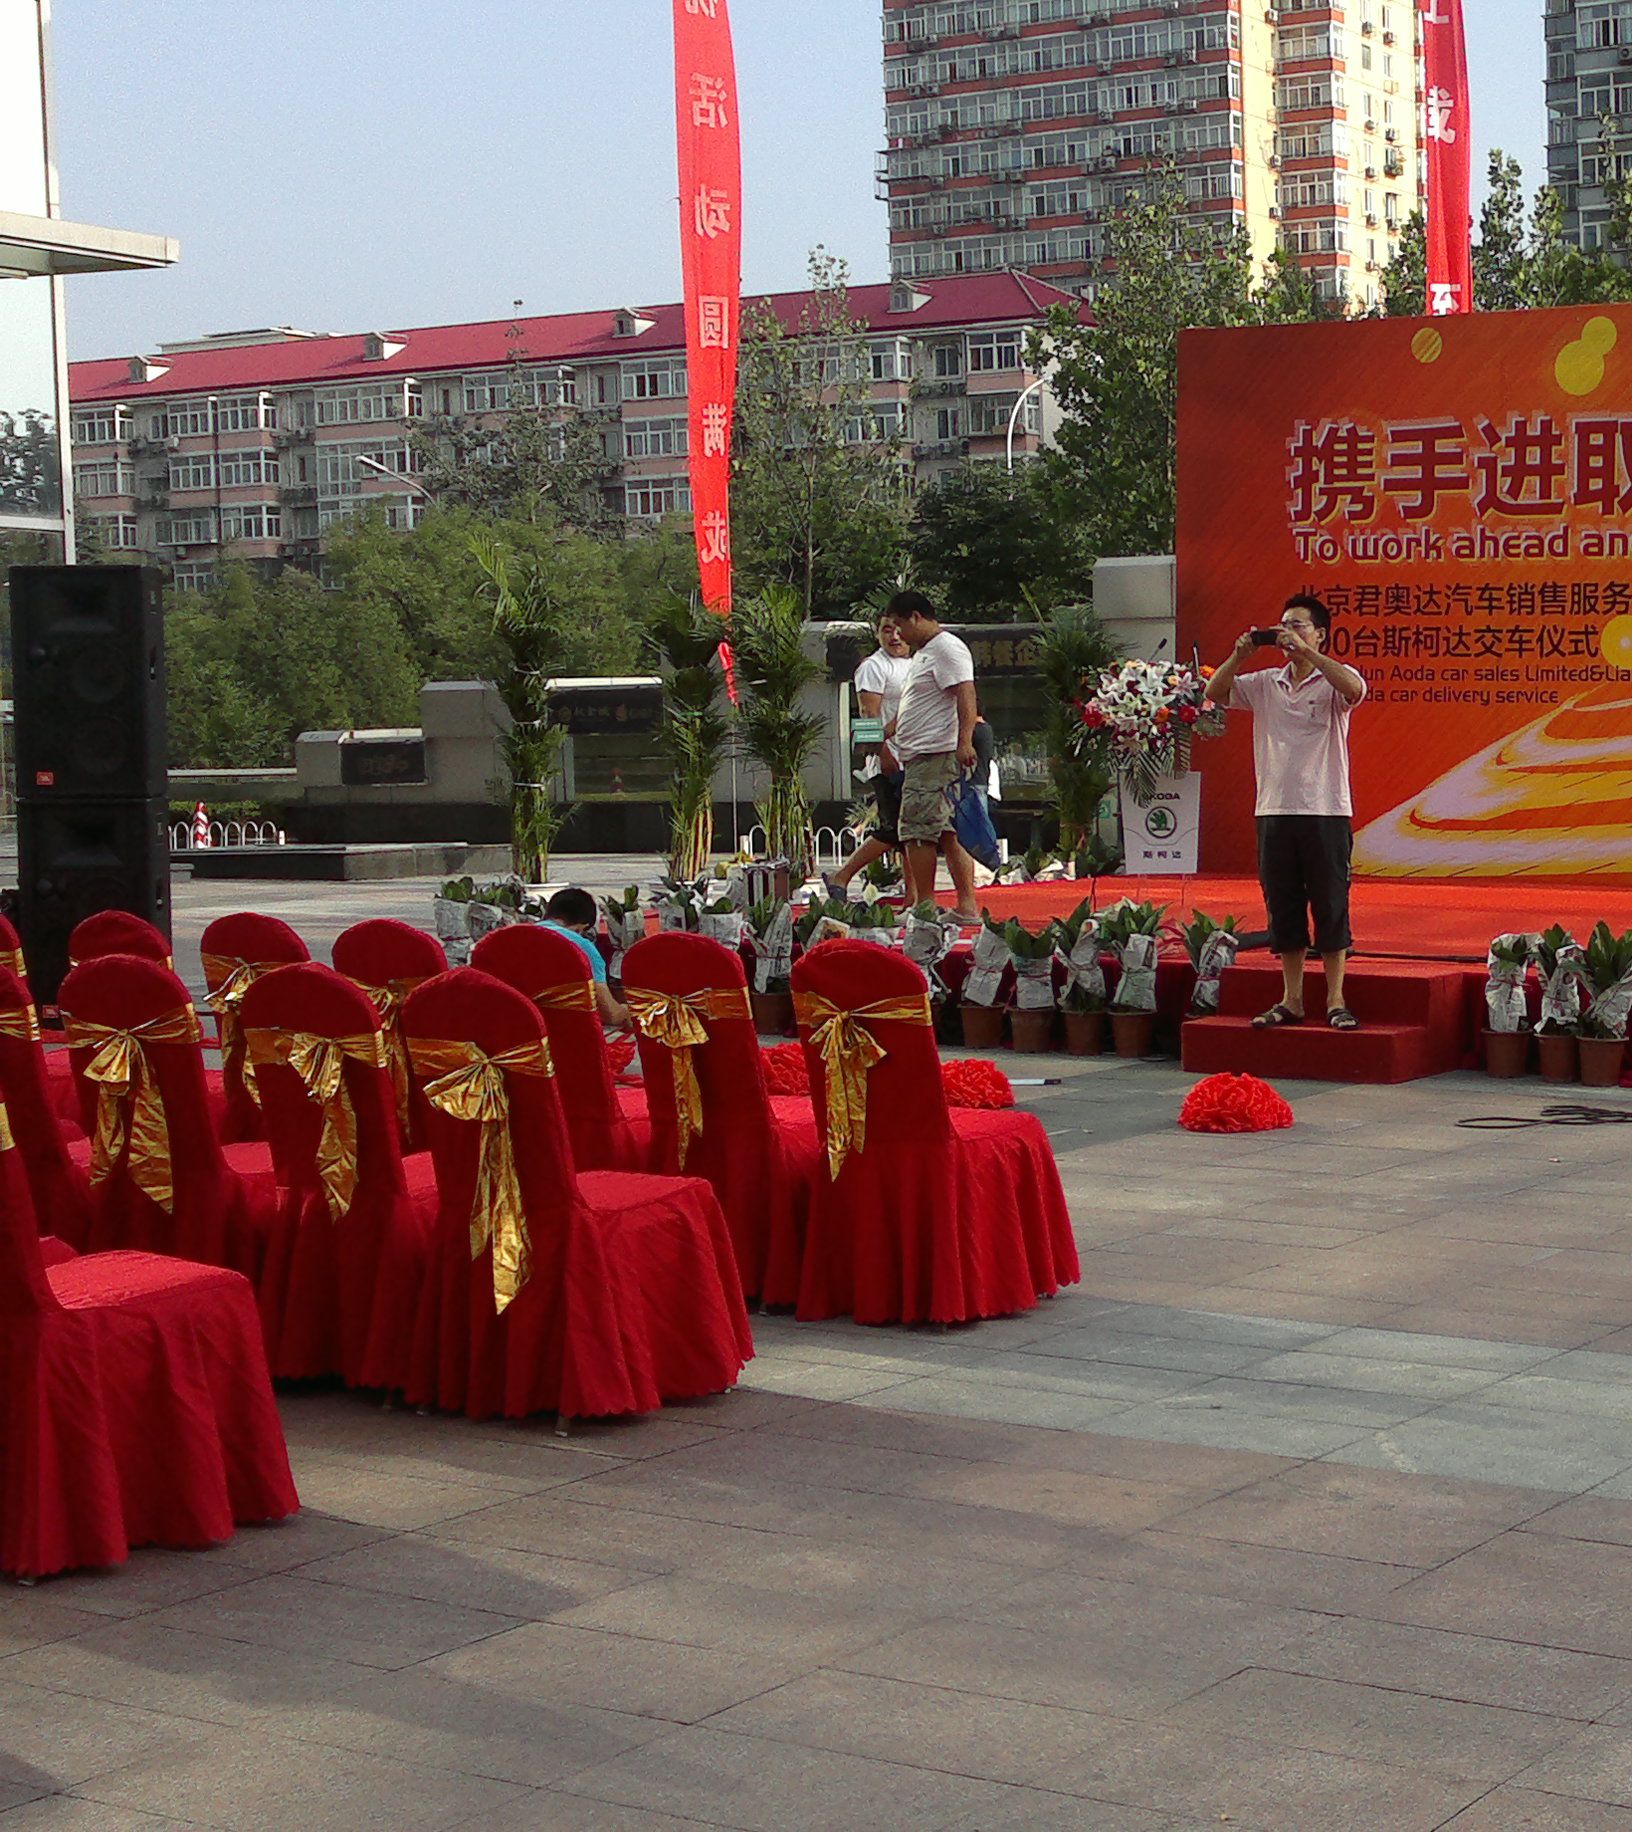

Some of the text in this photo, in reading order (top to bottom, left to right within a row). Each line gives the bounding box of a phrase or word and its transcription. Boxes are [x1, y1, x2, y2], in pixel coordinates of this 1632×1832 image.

[1294, 527, 1341, 563] To
[1347, 526, 1445, 562] work
[1452, 522, 1572, 561] ahead
[1389, 664, 1435, 682] Aoda
[1440, 668, 1469, 682] car
[1473, 665, 1520, 682] sales
[1390, 689, 1419, 702] car
[1422, 685, 1490, 706] delivery
[1495, 687, 1560, 704] service
[1147, 792, 1180, 801] KODA
